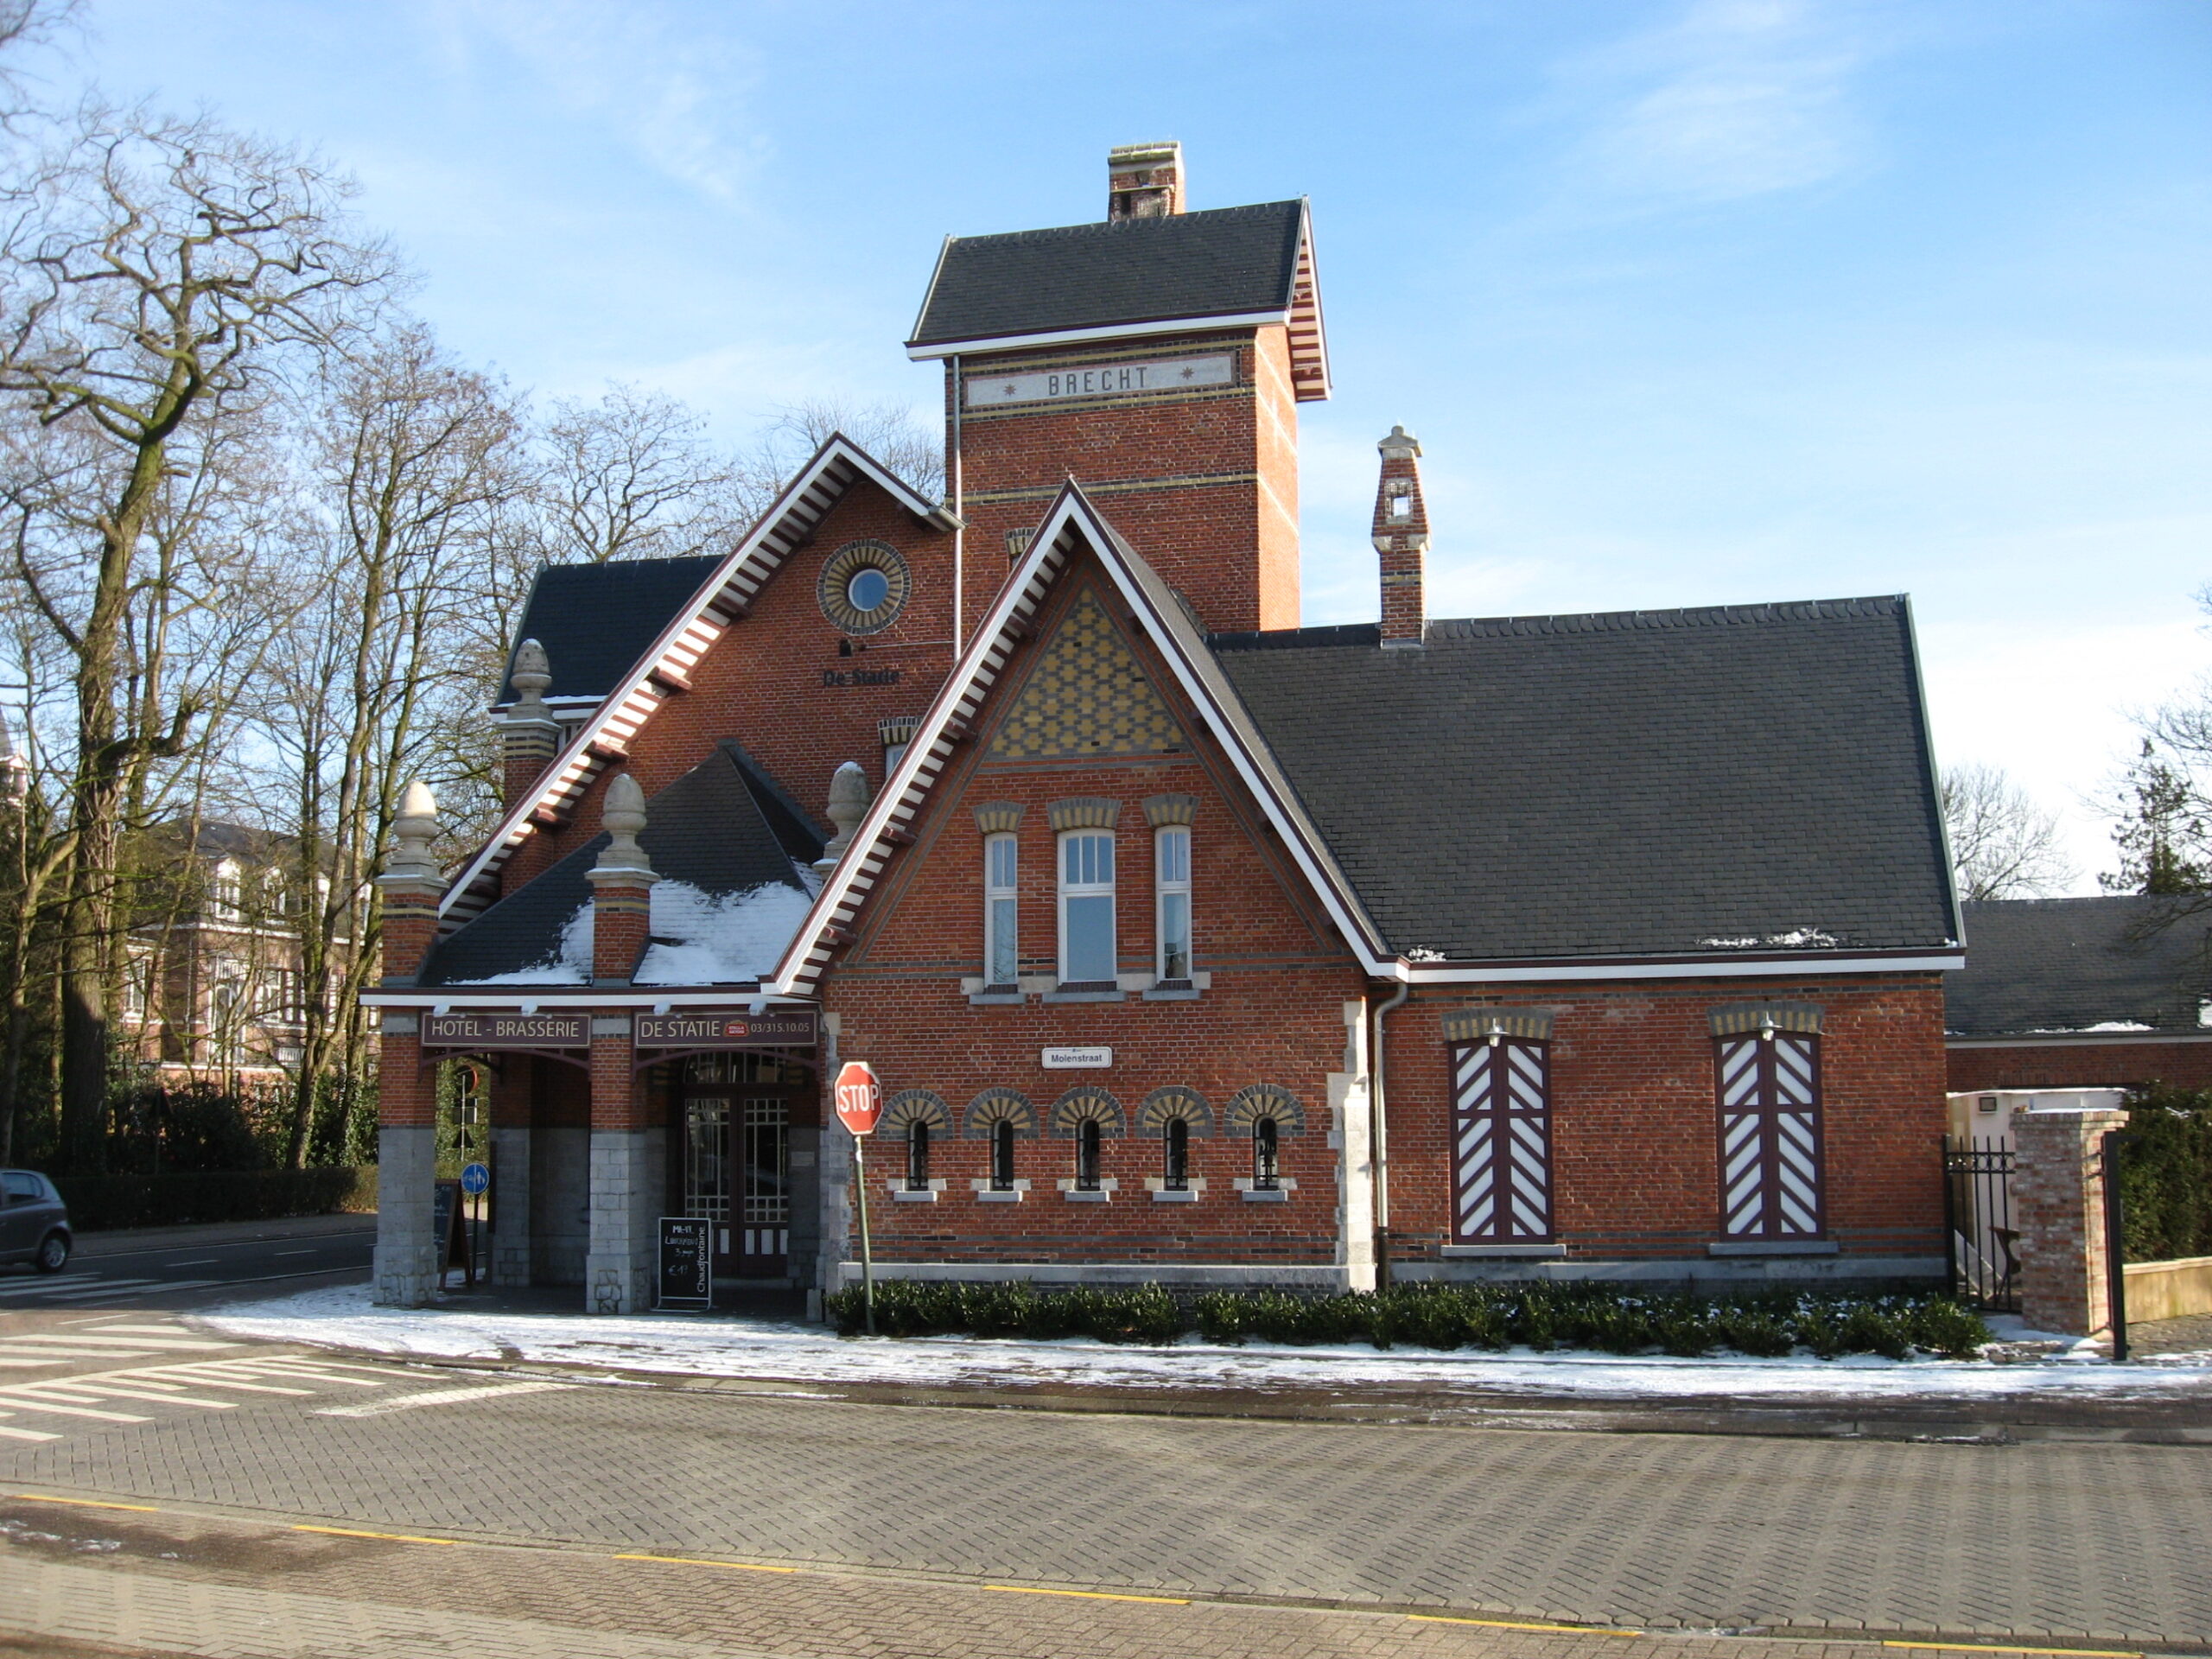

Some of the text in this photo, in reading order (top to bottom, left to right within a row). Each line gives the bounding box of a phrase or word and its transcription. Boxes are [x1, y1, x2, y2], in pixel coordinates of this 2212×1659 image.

[1048, 366, 1147, 396] BRECHT
[432, 1020, 482, 1037] HOTEL
[496, 1020, 580, 1037] BRASSERIE
[640, 1020, 810, 1038] DE STATIE 03/315.10.05
[1051, 1054, 1103, 1063] Molenstraat
[838, 1084, 880, 1113] STOP
[696, 1226, 709, 1294] Chaudfontaine
